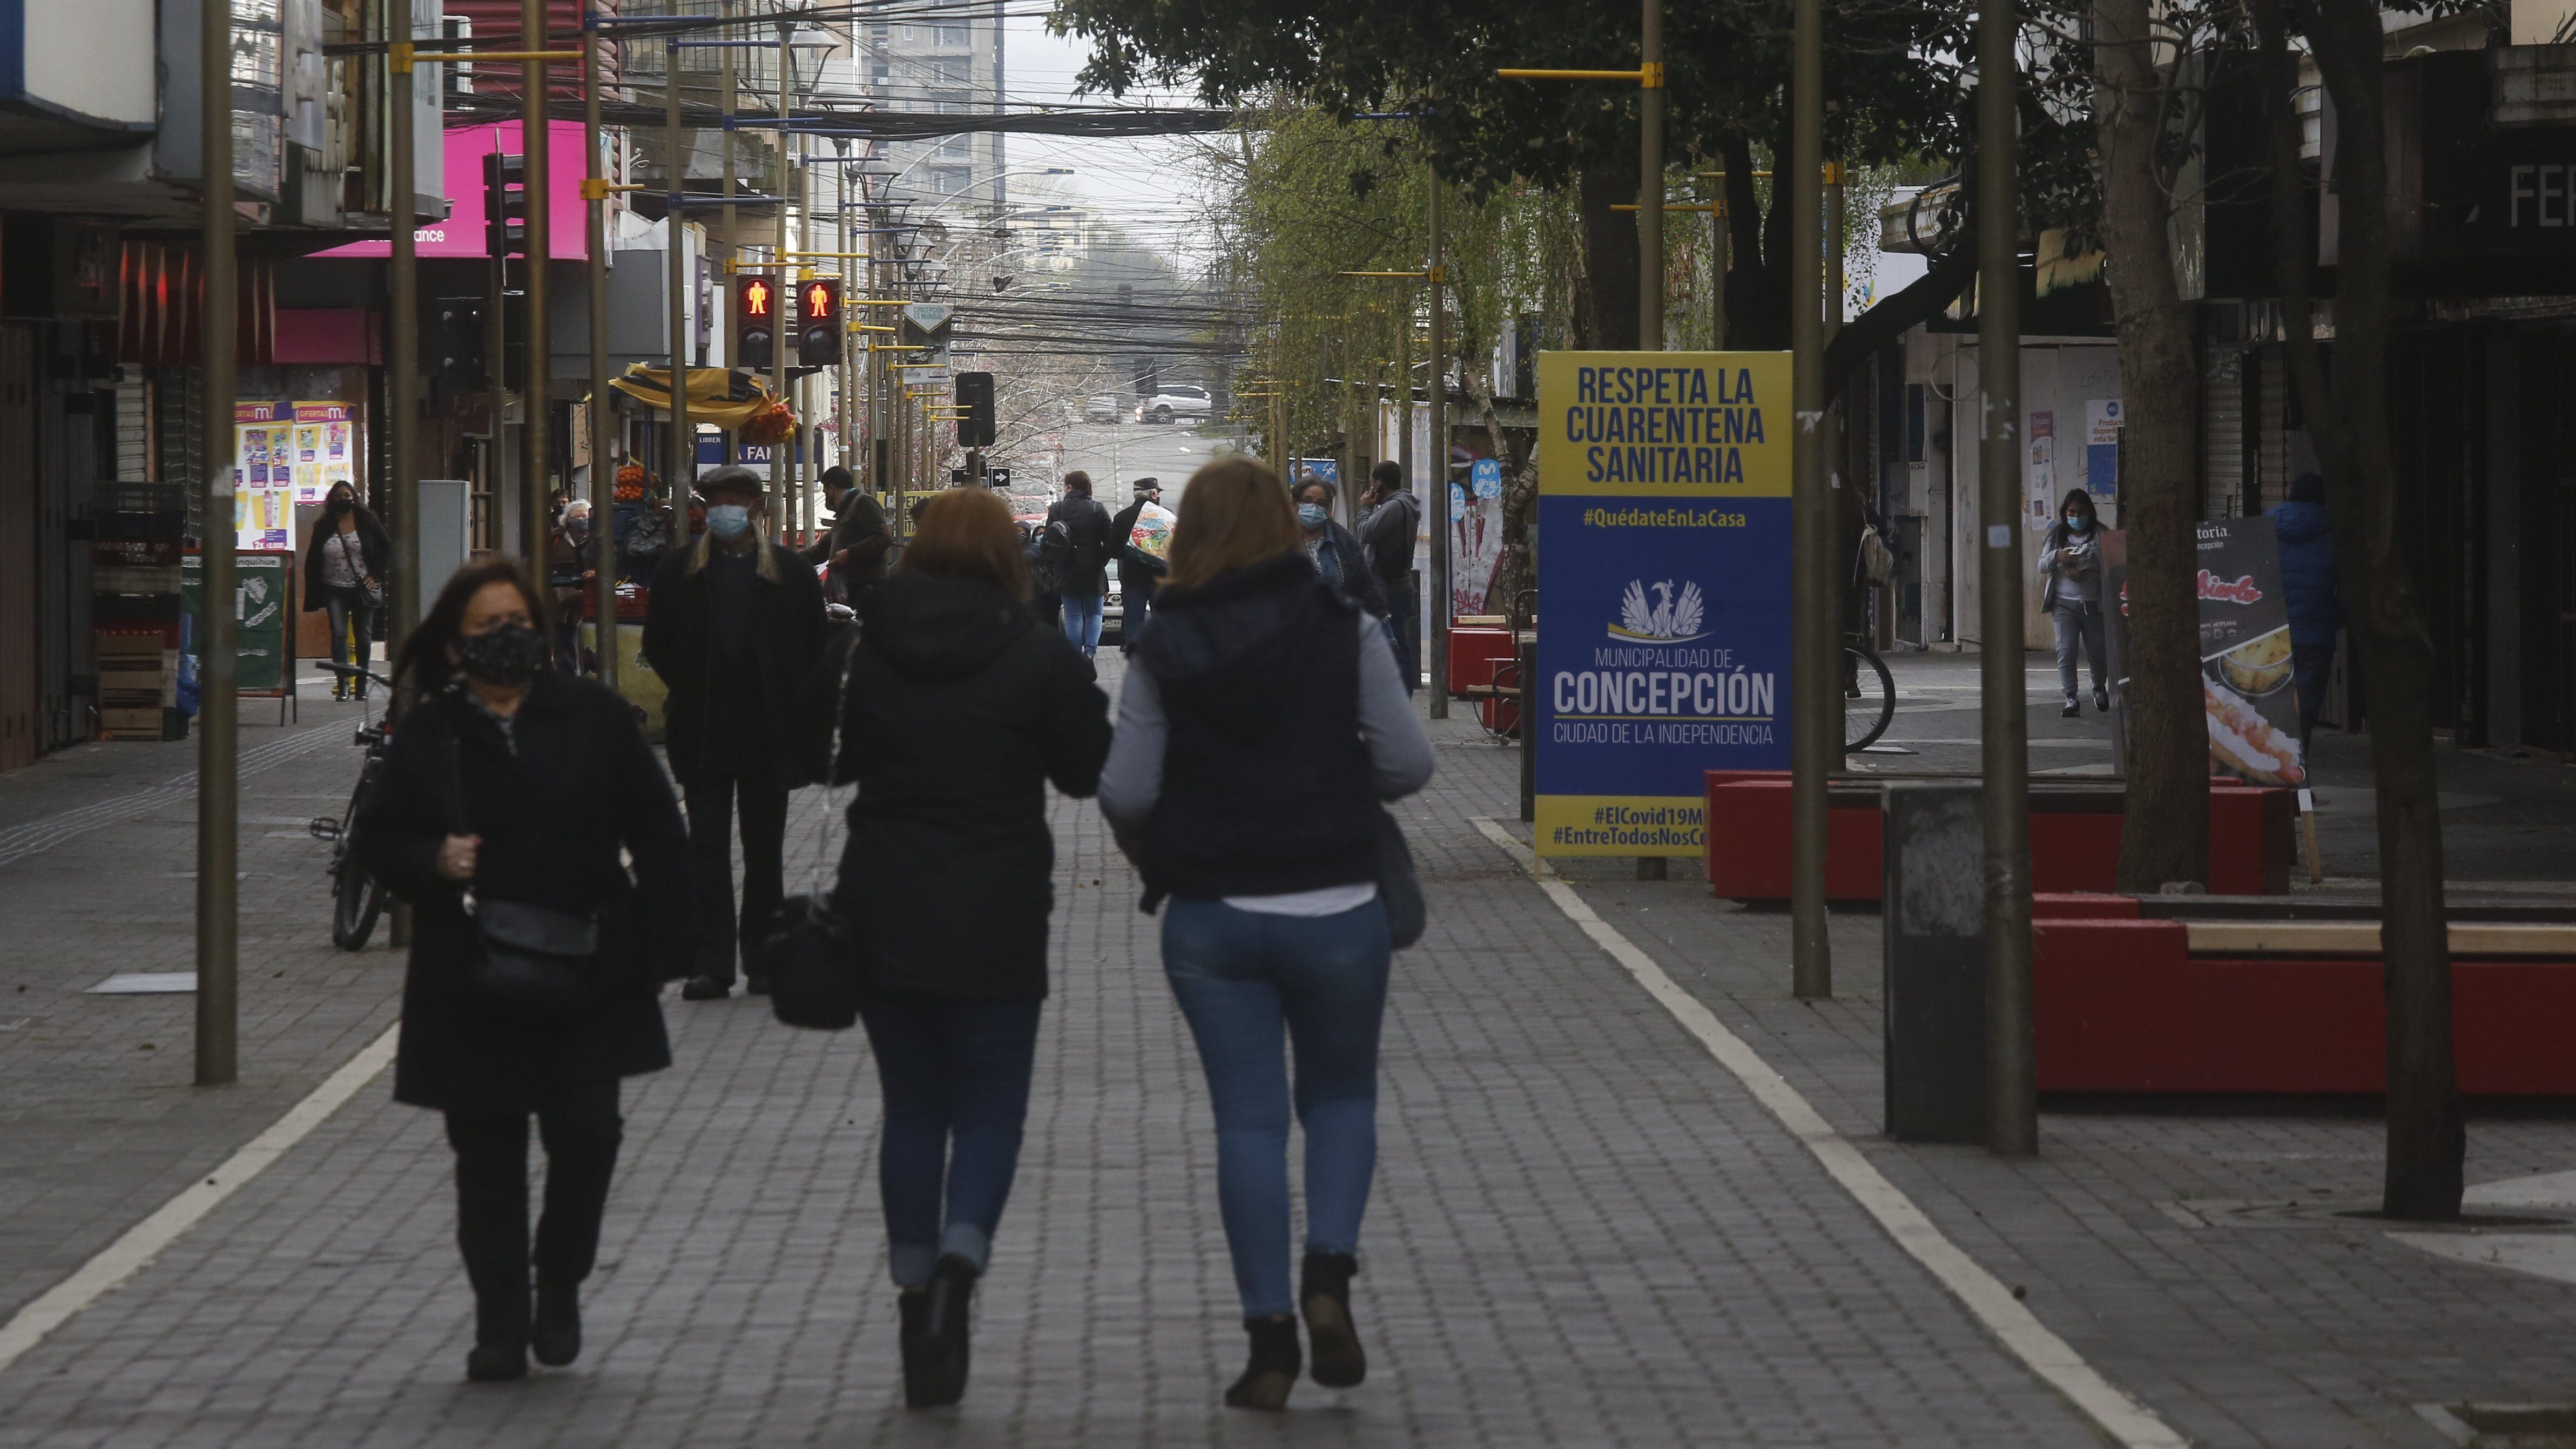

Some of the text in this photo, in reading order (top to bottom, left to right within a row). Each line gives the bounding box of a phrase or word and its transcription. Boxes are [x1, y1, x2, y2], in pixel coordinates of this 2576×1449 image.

[414, 230, 444, 242] ance
[1578, 367, 1755, 405] RESPETA LA
[1567, 406, 1765, 444] CUARENTENA
[1587, 446, 1744, 484] SANITARIA
[1583, 508, 1746, 528] #QuédateEnLaCasa
[2197, 525, 2230, 539] toria.
[2197, 541, 2223, 550] ncepción
[1595, 648, 1733, 668] MUNICIPALIDAD DE
[1553, 664, 1775, 716] CONCEPCIÓN
[1553, 723, 1774, 745] CIUDAD DE LA INDEPENDENCIA
[1595, 807, 1703, 826] #ElCovid19M
[1553, 827, 1705, 846] #EntreTodosNosC
